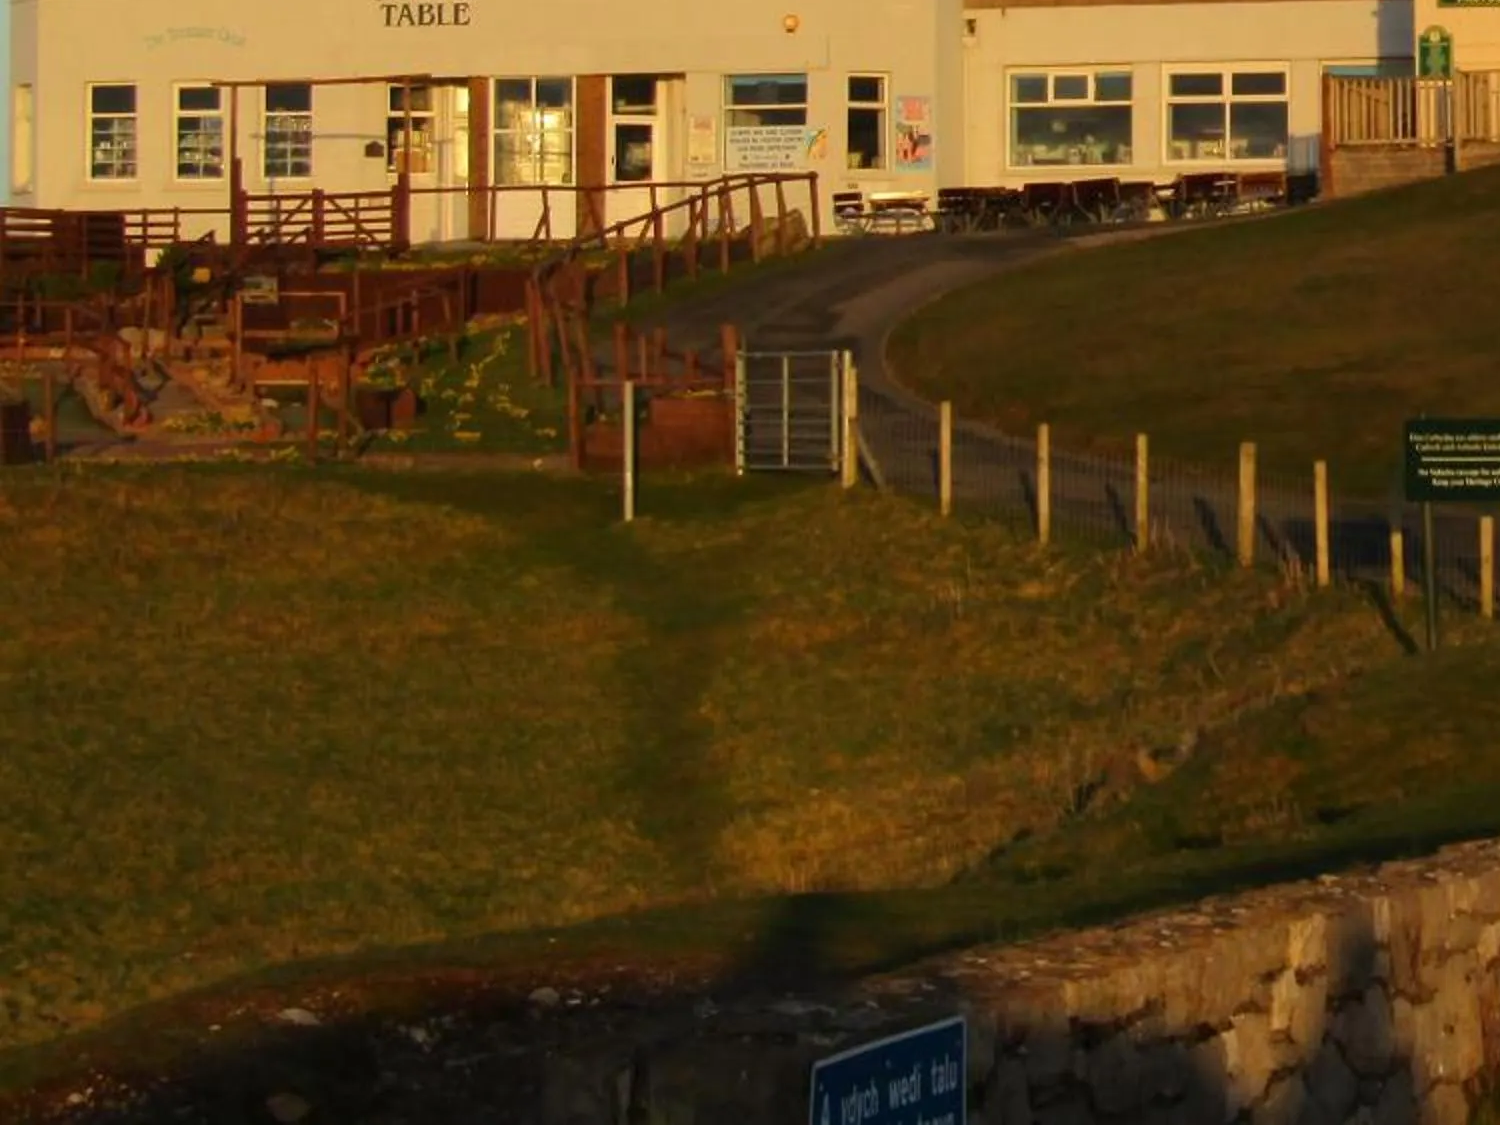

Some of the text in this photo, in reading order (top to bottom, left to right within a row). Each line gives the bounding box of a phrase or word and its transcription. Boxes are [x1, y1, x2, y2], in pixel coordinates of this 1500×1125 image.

[380, 2, 472, 27] TABLE
[889, 1061, 921, 1110] wedi
[931, 1053, 958, 1096] talu
